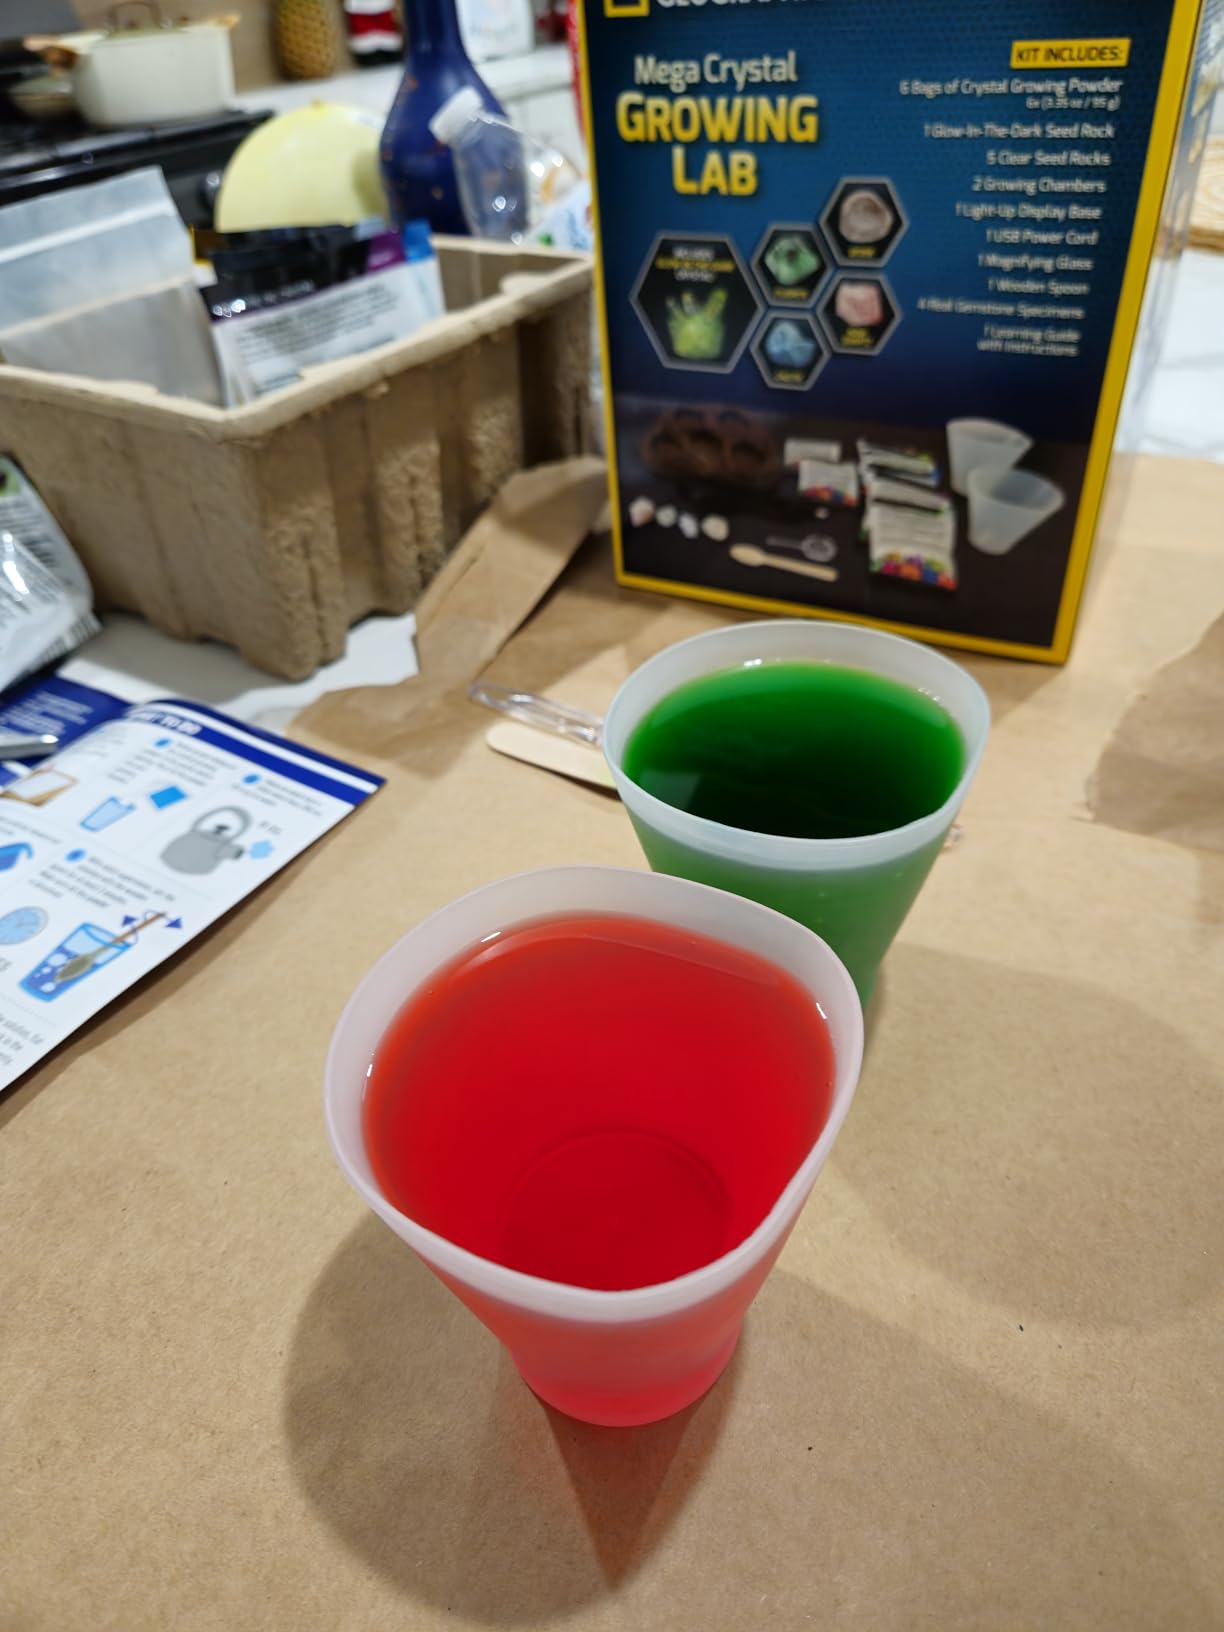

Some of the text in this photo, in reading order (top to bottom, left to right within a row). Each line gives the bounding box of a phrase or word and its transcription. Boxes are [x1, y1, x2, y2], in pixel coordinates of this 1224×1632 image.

[1016, 46, 1122, 62] KIT INCLUDES:
[634, 50, 798, 93] Mega Crystal
[911, 79, 942, 98] Bags
[943, 78, 960, 94] of
[960, 79, 1008, 96] Crystal
[1010, 79, 1067, 97] Growing
[1068, 77, 1123, 93] Powder
[616, 90, 818, 142] GROWING
[1045, 122, 1079, 138] Seed
[1080, 122, 1115, 138] Rock
[998, 150, 1032, 165] Clear
[1034, 150, 1067, 166] Seed
[1069, 151, 1111, 166] Rocks
[672, 144, 757, 195] LAB
[972, 176, 1106, 196] 2 Growing Chambers
[1018, 203, 1066, 221] Display
[1068, 205, 1102, 220] Base
[993, 230, 1020, 244] USB
[1022, 230, 1064, 244] Power
[1065, 230, 1099, 246] Cord
